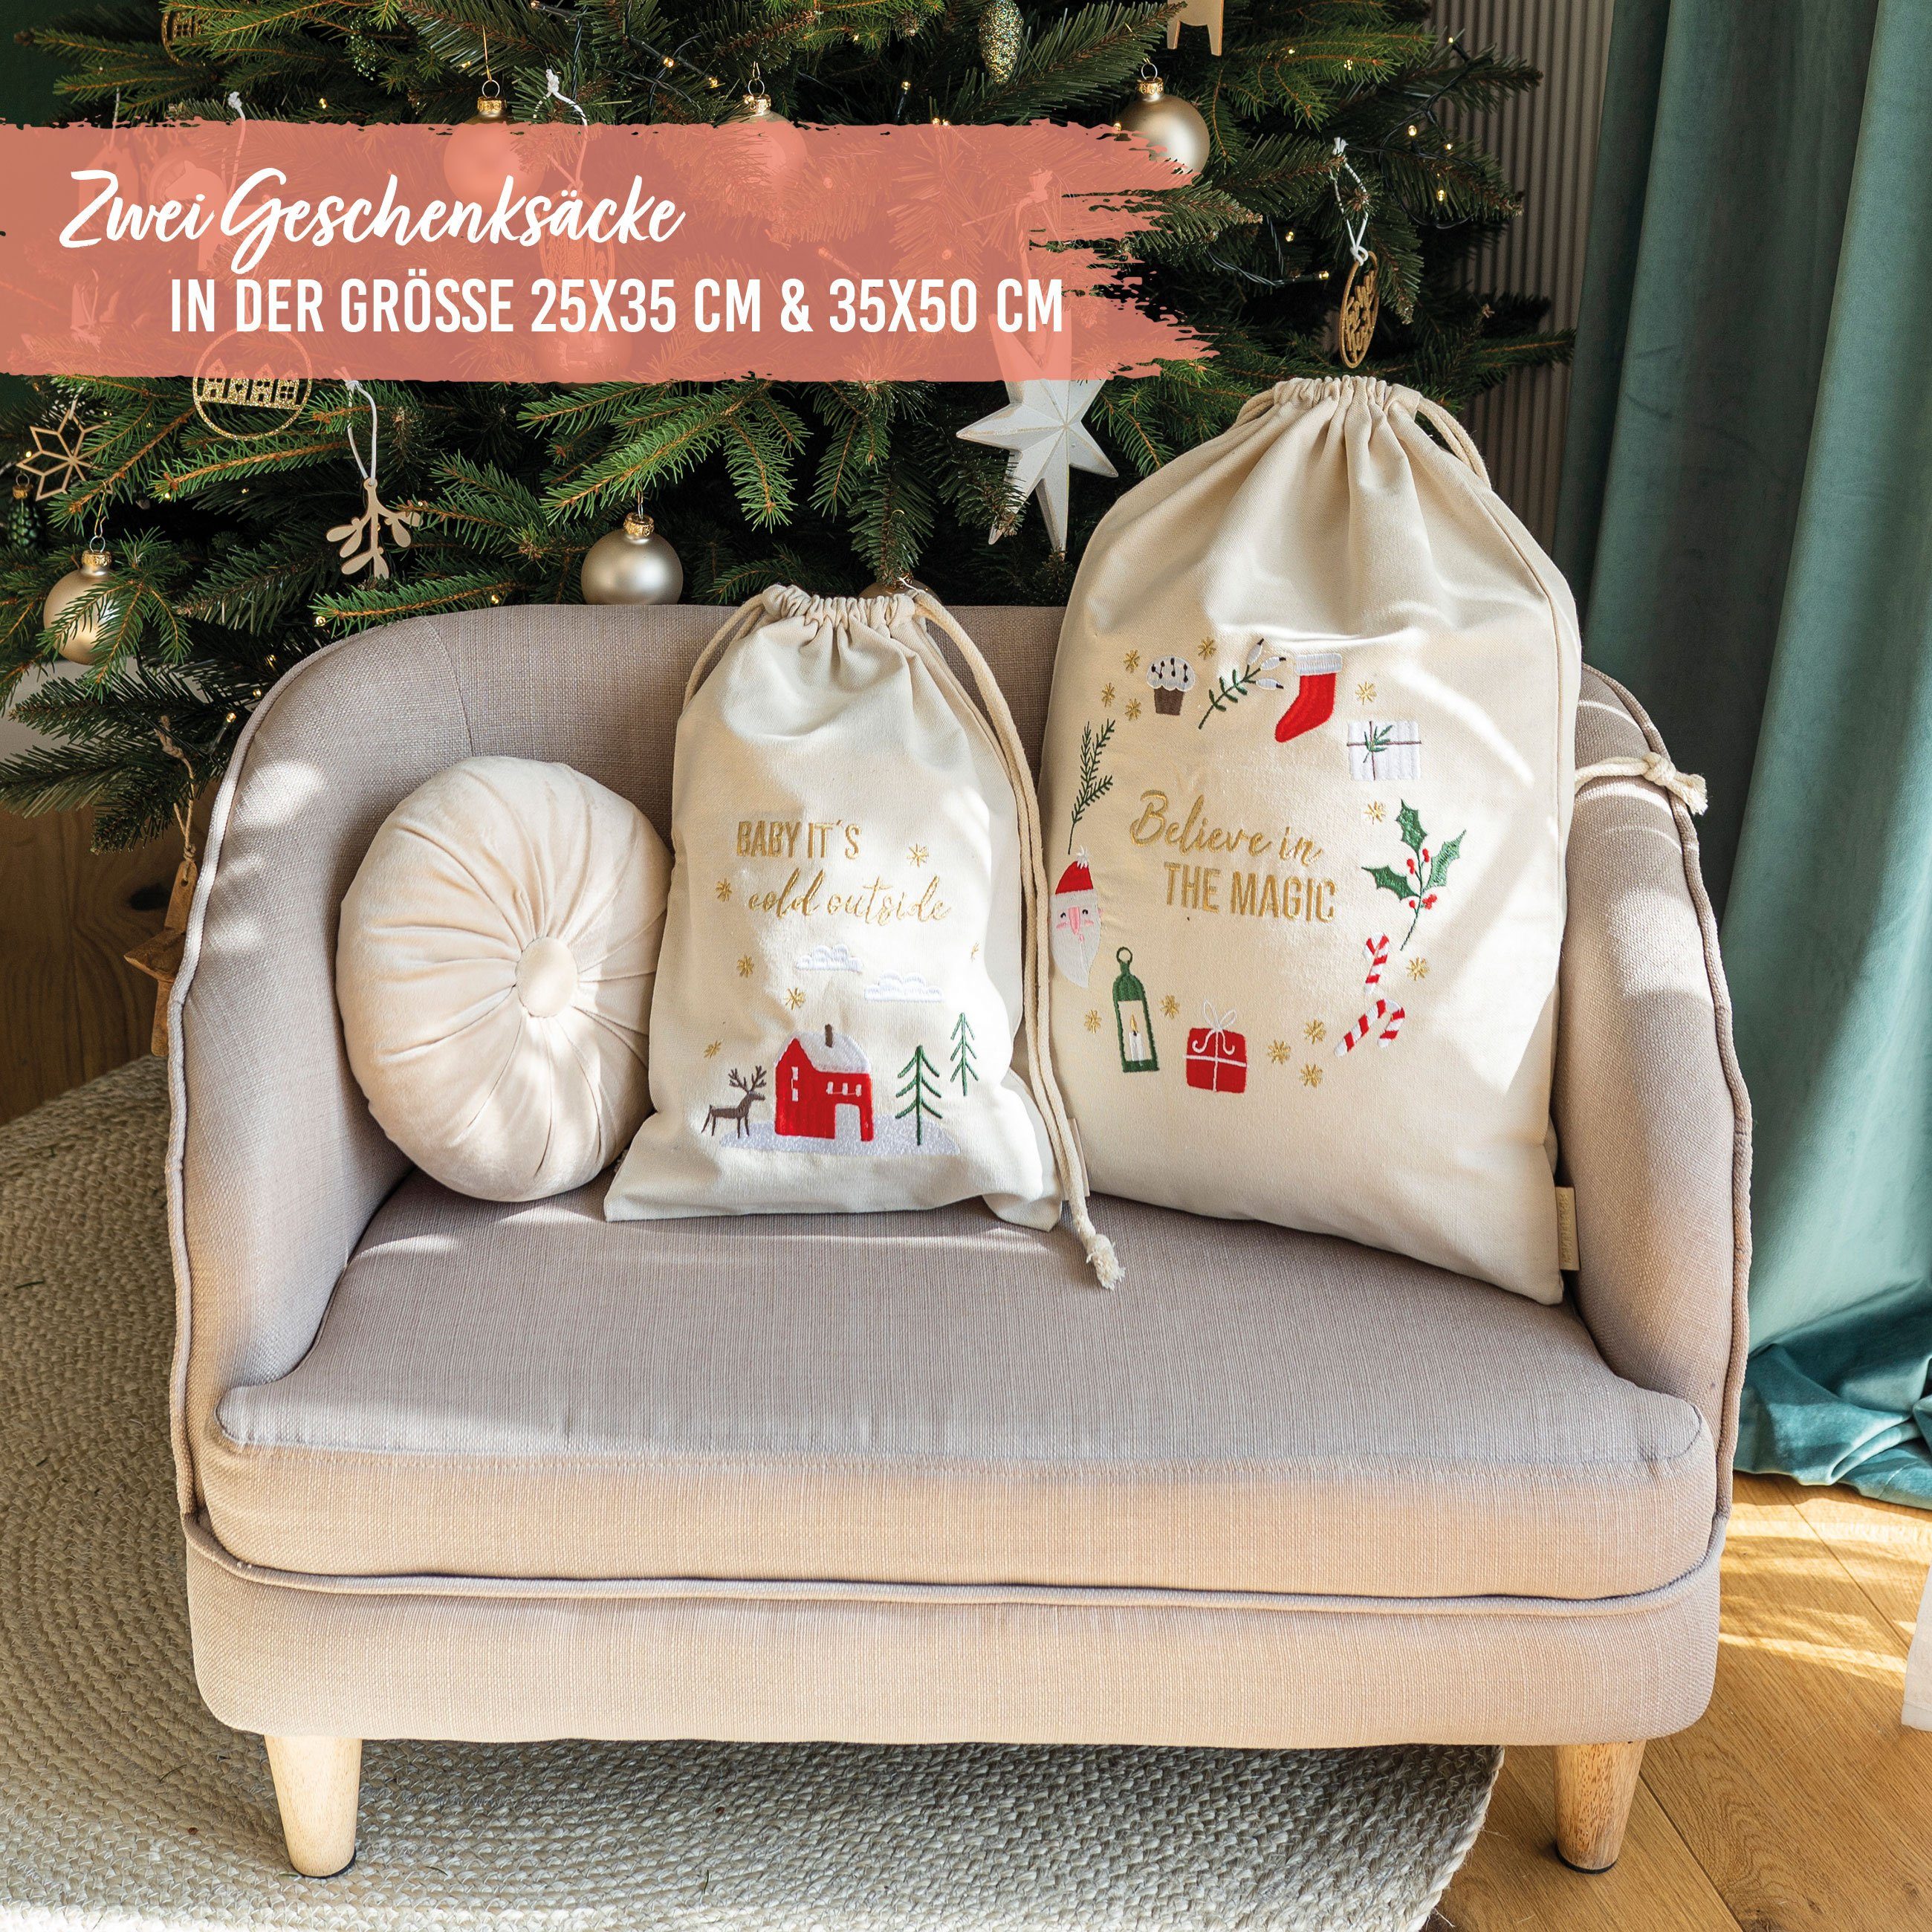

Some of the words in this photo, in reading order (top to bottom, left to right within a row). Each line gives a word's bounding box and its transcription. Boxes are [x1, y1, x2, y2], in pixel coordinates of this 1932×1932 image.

[736, 820, 803, 858] BABY
[1129, 789, 1272, 855] Believe
[1278, 826, 1324, 866] in
[748, 868, 825, 919] cold
[827, 875, 952, 926] outside
[1164, 861, 1221, 913] THE
[1230, 870, 1338, 923] MAGIC
